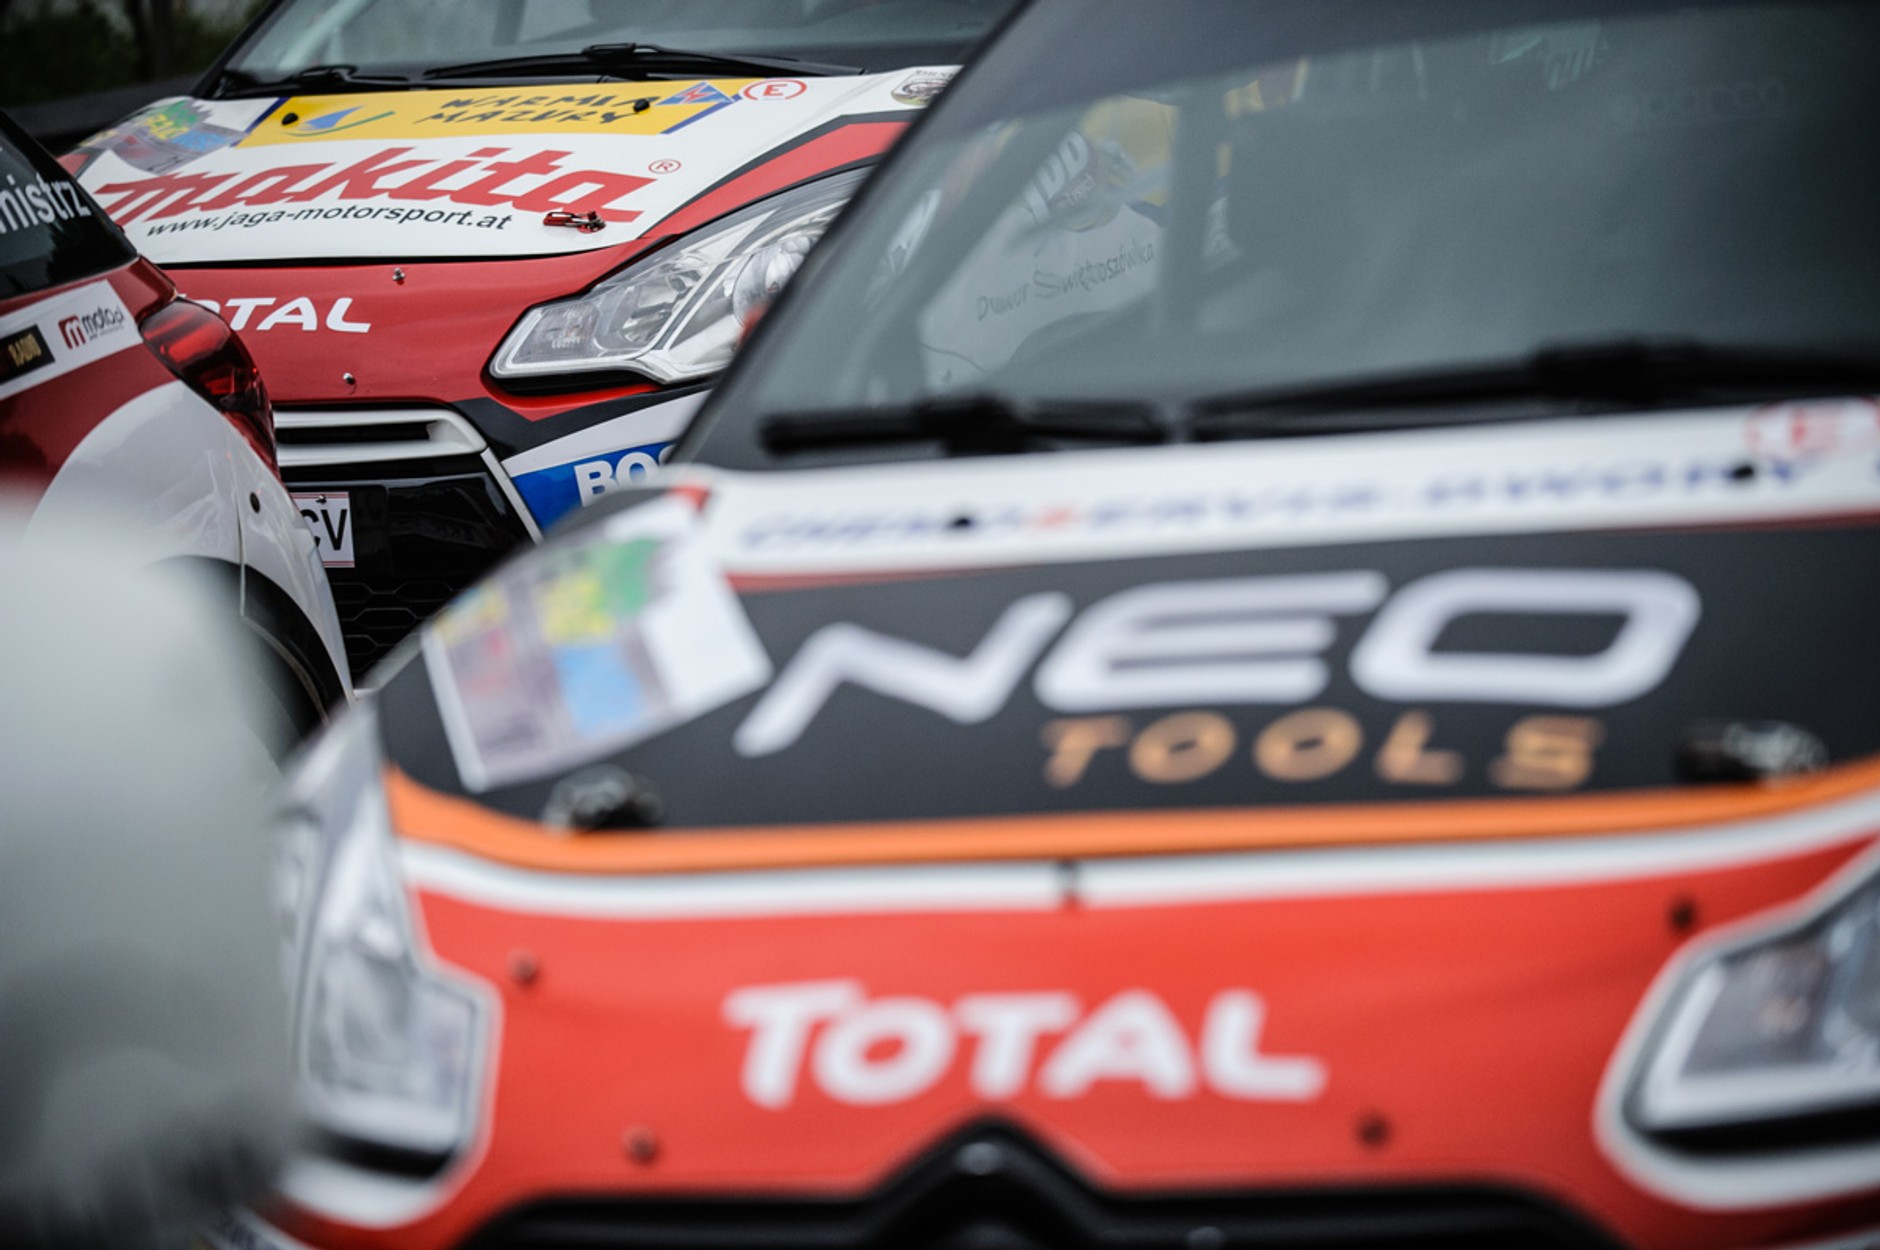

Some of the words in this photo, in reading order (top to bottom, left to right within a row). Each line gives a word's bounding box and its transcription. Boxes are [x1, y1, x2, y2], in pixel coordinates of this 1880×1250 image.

[94, 147, 658, 226] makita
[147, 204, 512, 238] www.jaga-motorsport.at
[178, 293, 372, 333] TAL
[574, 444, 676, 508] BO
[733, 567, 1702, 758] NEO
[1040, 707, 1604, 790] TOOLS
[722, 978, 1328, 1110] TOTAL
